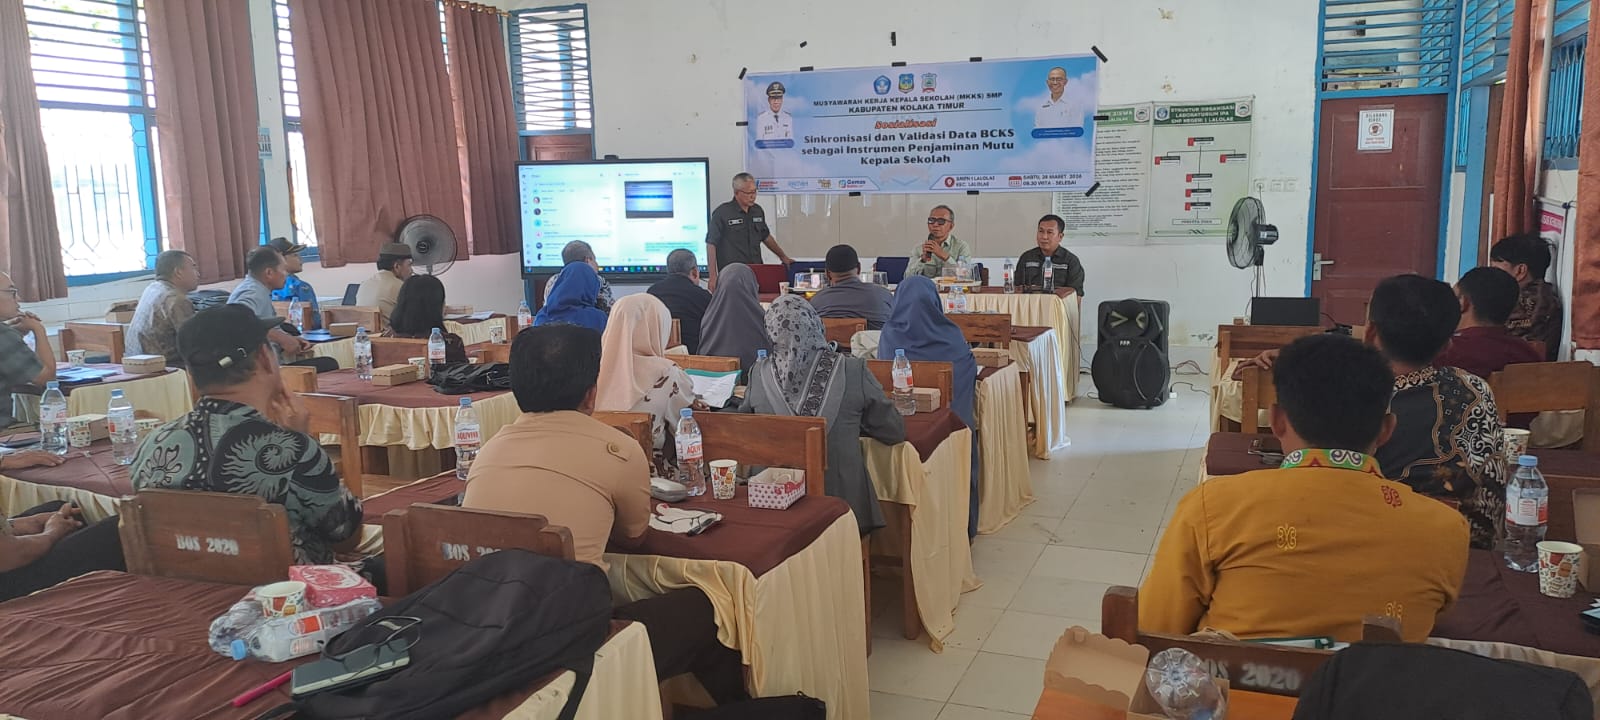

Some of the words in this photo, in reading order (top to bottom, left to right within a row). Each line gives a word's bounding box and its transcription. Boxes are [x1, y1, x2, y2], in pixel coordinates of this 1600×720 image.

[864, 97, 888, 105] KERJA
[919, 94, 955, 102] SEKOLAH
[956, 92, 984, 100] (MKKS)
[848, 105, 898, 113] KABUPATEN
[900, 103, 934, 111] KOLAKA
[1201, 104, 1235, 112] ORGANISASI
[874, 118, 937, 129] Sosialisasi
[804, 133, 872, 144] Sinkronisasi
[874, 132, 896, 142] dan
[899, 131, 945, 141] Validasi
[948, 130, 977, 139] Data
[980, 128, 1015, 138] BCKS
[801, 146, 844, 156] sebagai
[846, 144, 905, 154] Instrumen
[908, 142, 979, 154] Penjaminan
[982, 141, 1014, 150] Mutu
[860, 156, 900, 166] Kepala
[903, 154, 951, 164] Sekolah
[175, 534, 201, 551] BOS
[206, 537, 239, 556] 2020
[442, 543, 470, 561] BOS
[1241, 662, 1300, 690] 2020
